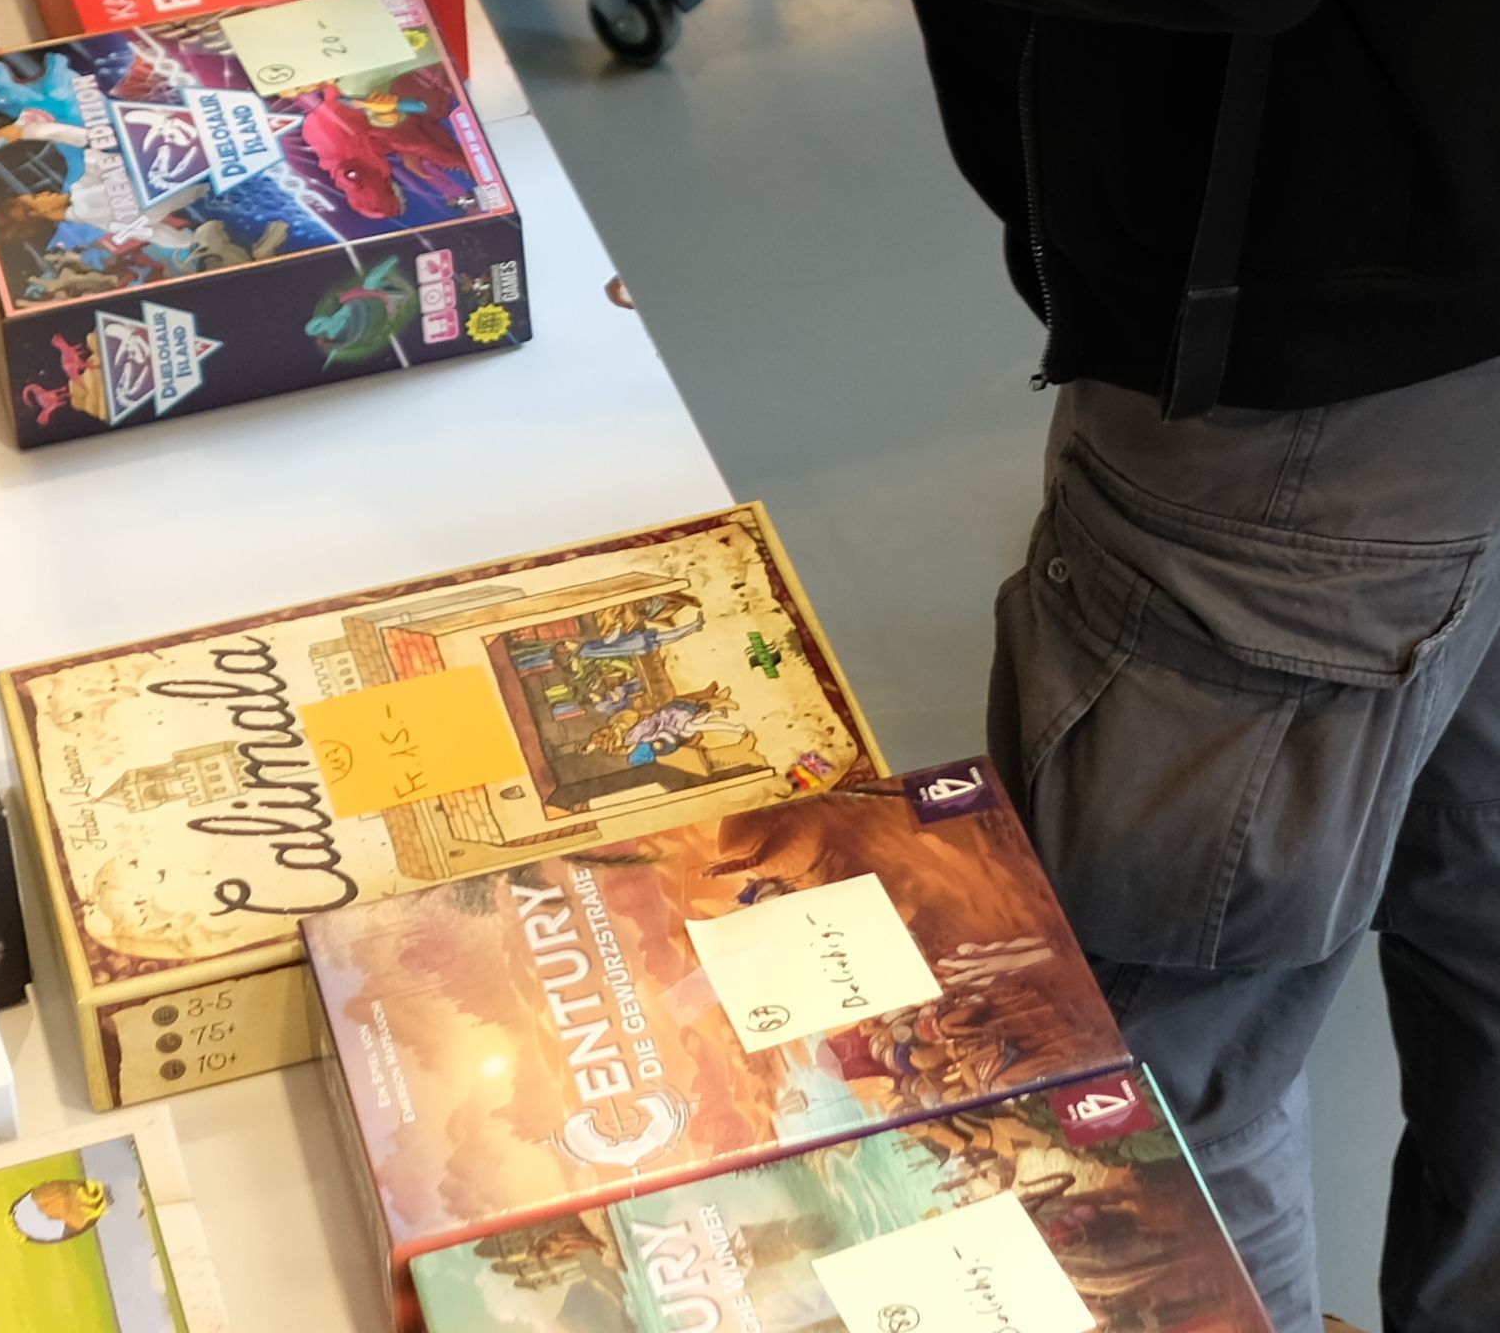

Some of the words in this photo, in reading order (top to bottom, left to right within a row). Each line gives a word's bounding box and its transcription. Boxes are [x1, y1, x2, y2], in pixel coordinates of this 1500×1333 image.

[80, 73, 115, 153] EDITION
[202, 90, 247, 179] DUELOSAUR
[235, 102, 270, 174] ISLAND
[99, 147, 154, 251] XTREME
[499, 258, 520, 303] GAMES
[156, 310, 185, 400] DUELOSAUR
[172, 322, 201, 389] ISLAND
[145, 633, 360, 917] Calimala
[187, 994, 234, 1017] 3-5
[190, 1021, 236, 1047] 75+
[510, 880, 690, 1167] CENTURY
[197, 1051, 239, 1072] 10+
[390, 1057, 416, 1125] EMERSON
[631, 1036, 665, 1082] DIE
[697, 1200, 744, 1300] WUNDER
